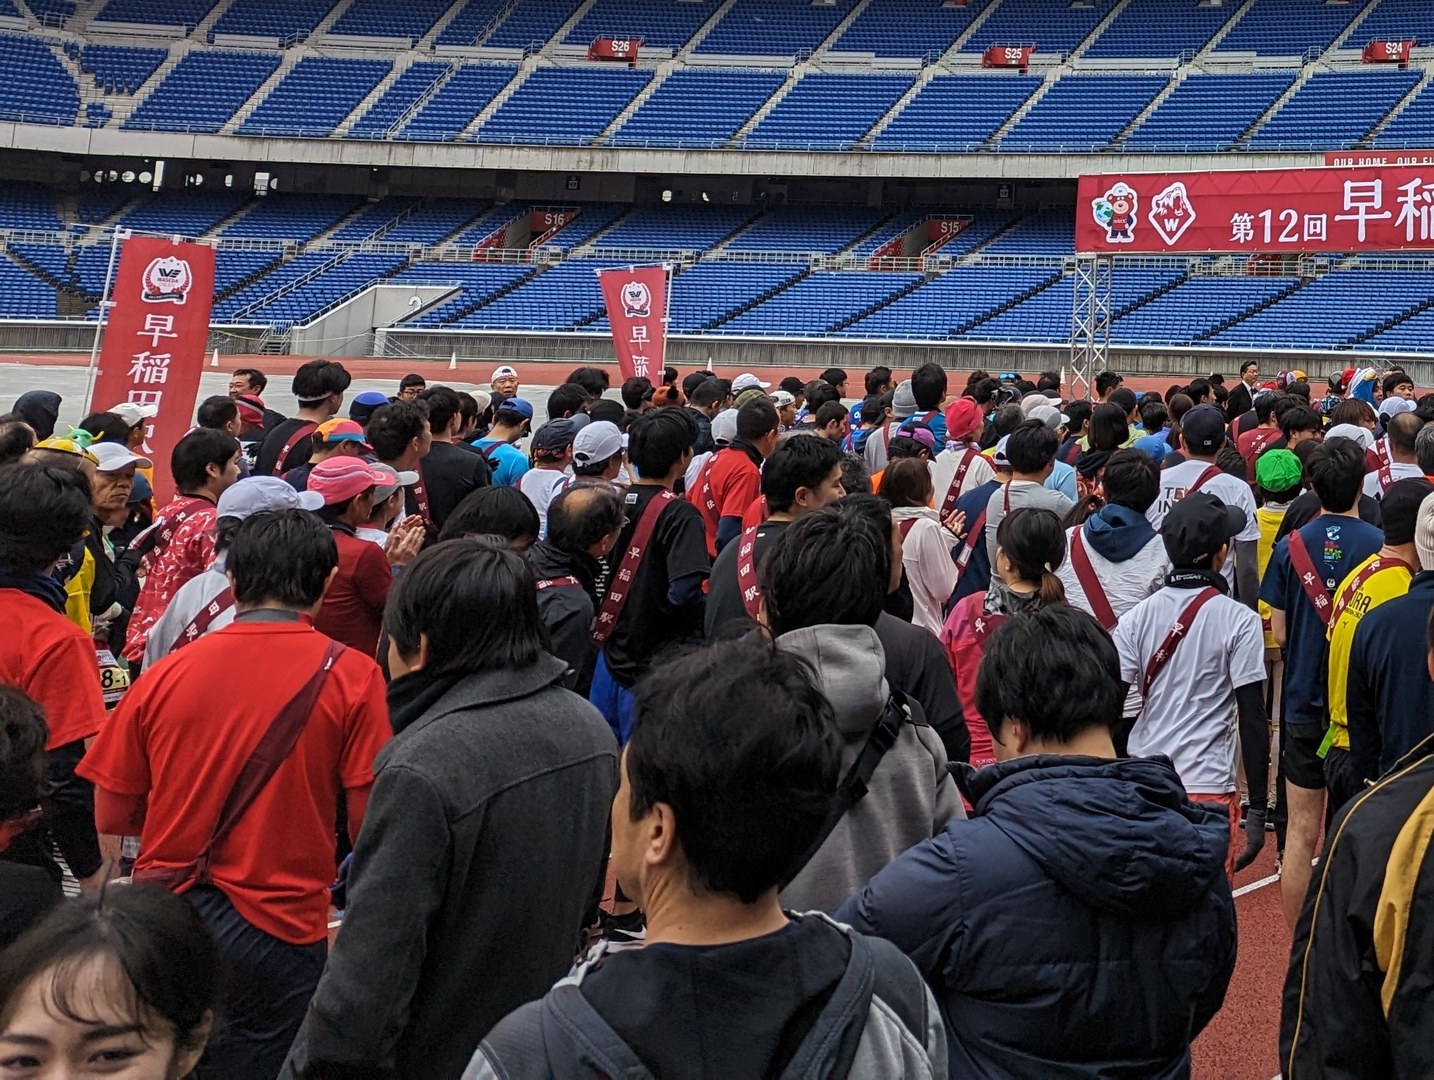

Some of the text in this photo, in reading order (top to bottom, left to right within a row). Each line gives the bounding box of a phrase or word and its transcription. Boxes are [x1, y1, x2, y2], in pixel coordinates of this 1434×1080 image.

[611, 40, 630, 52] S26
[1385, 42, 1404, 55] S24
[1004, 47, 1023, 59] S25
[544, 213, 565, 227] S16
[1164, 218, 1180, 232] W
[940, 221, 960, 233] S15
